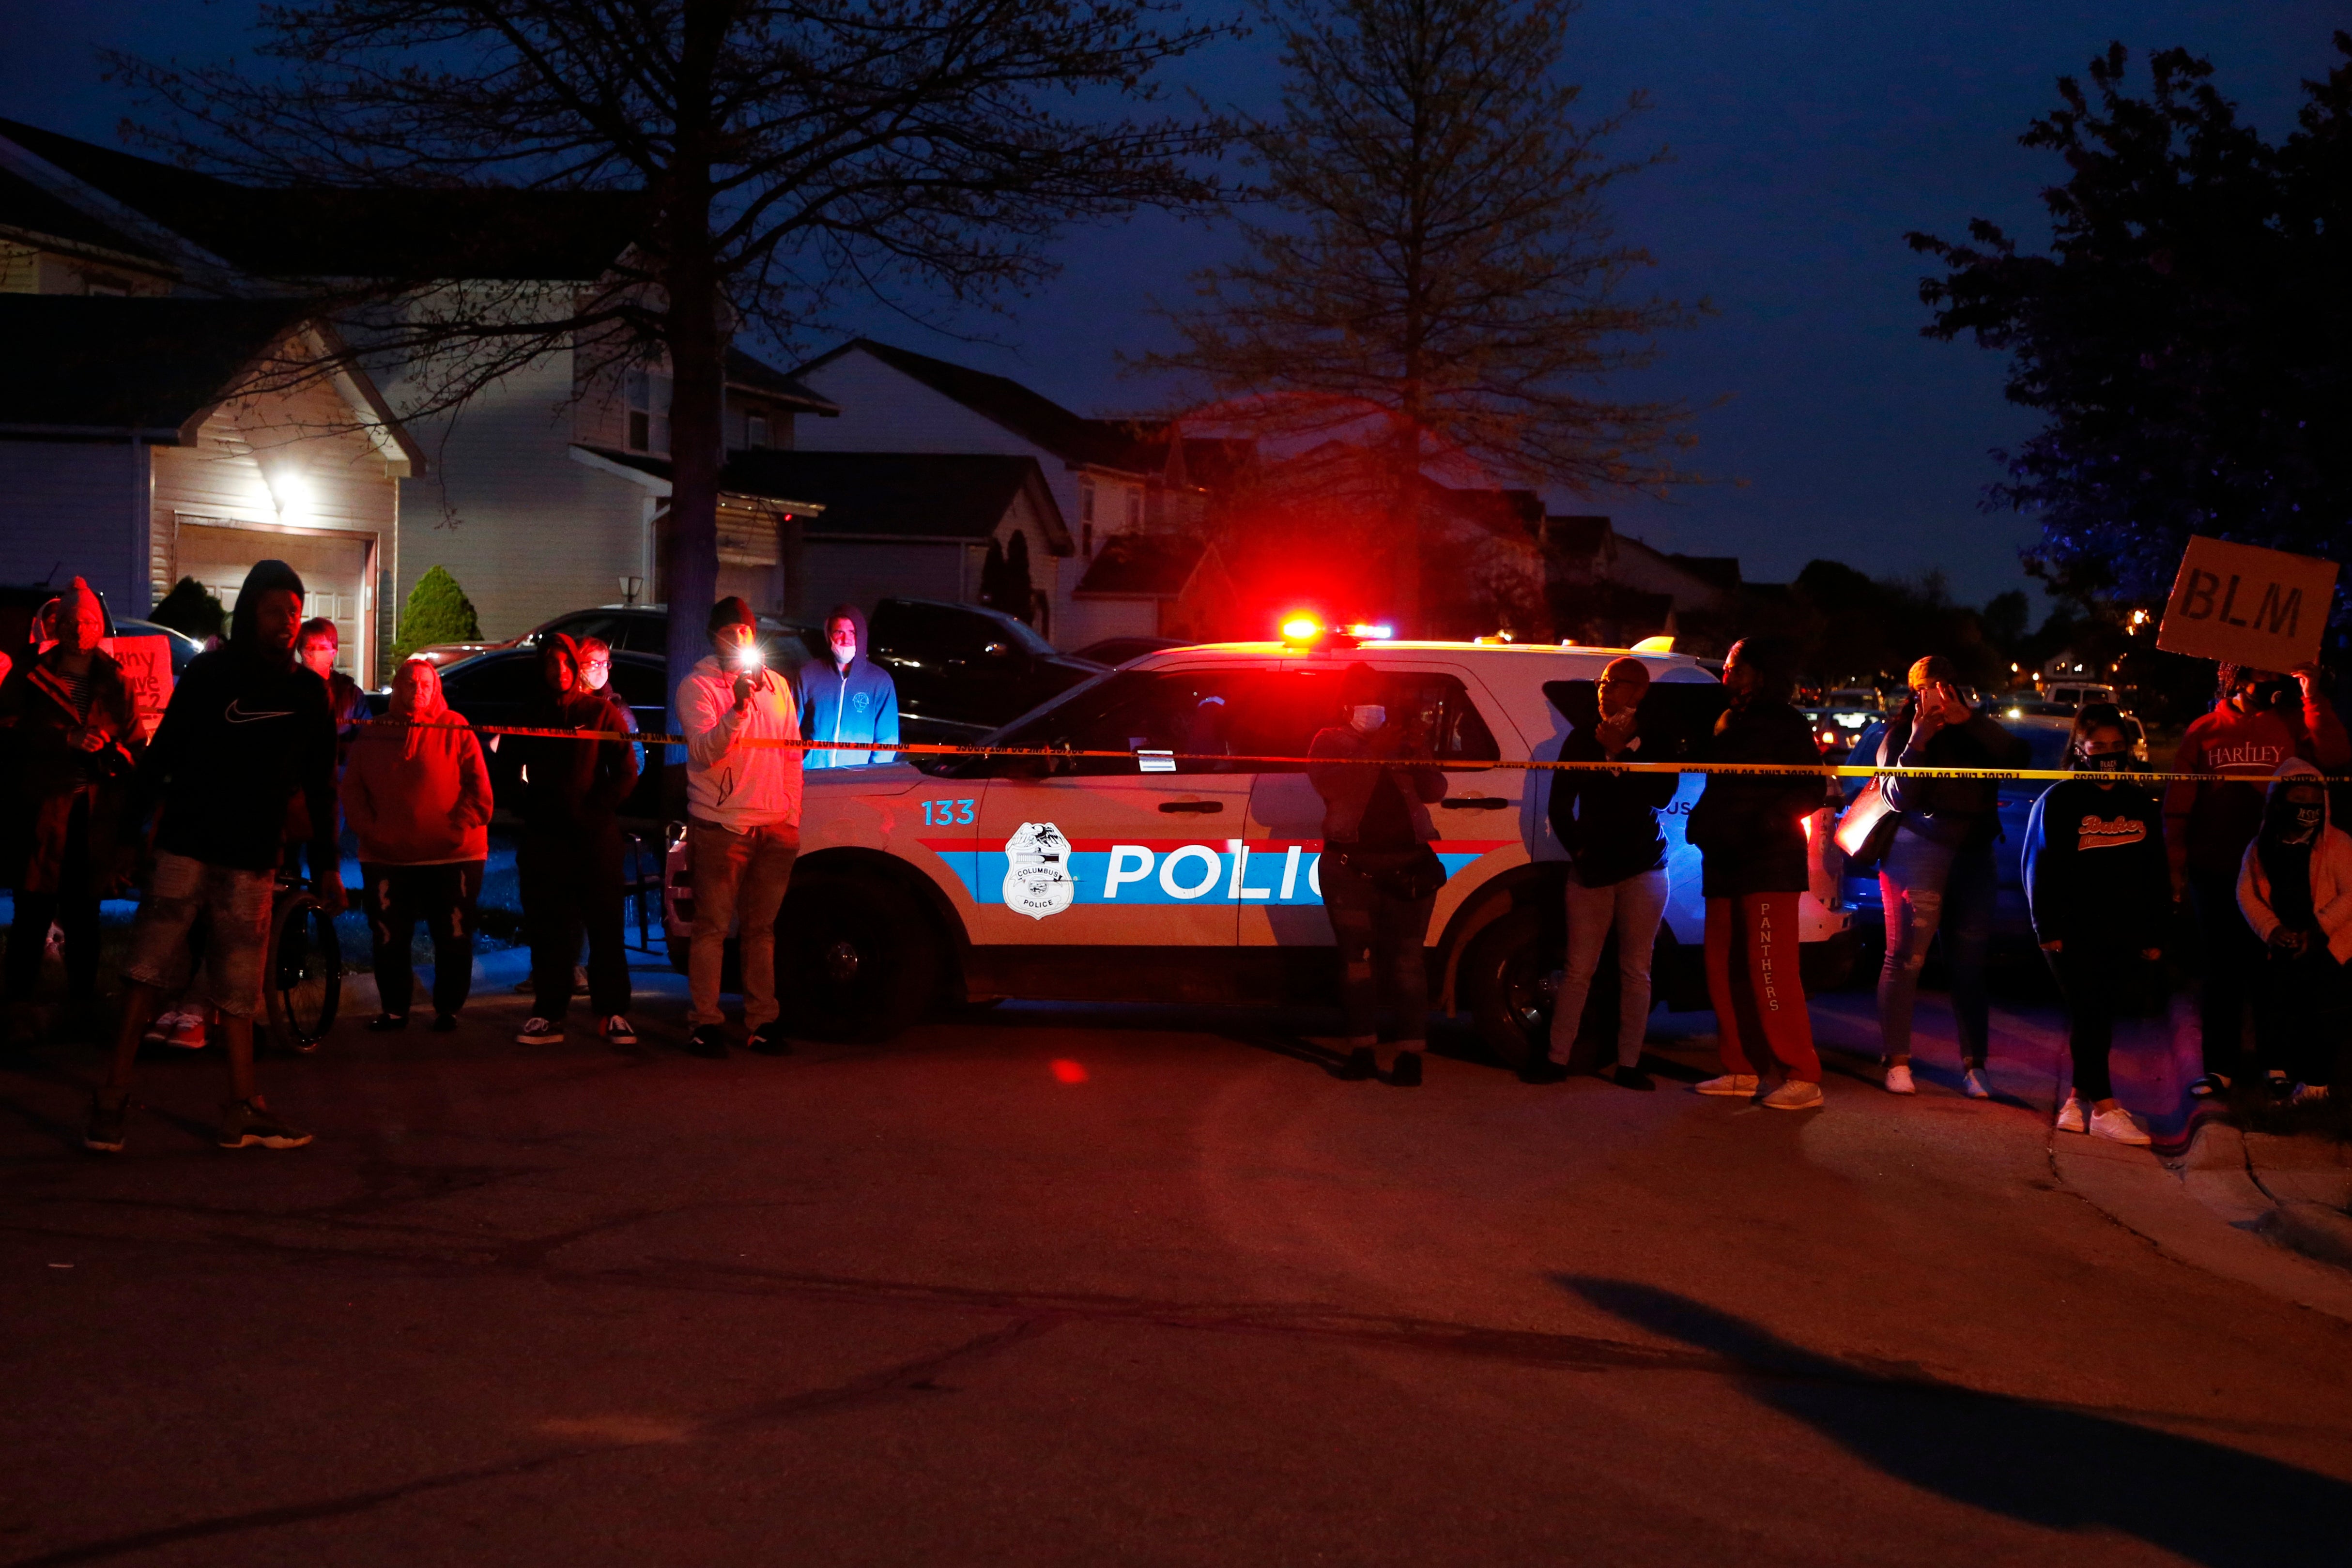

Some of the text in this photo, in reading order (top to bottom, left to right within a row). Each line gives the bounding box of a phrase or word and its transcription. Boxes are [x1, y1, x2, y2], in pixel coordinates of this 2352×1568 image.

[2179, 568, 2303, 638] BLM
[114, 652, 155, 677] any
[2209, 741, 2285, 765] HARTLEY
[922, 799, 975, 826] 133
[1017, 868, 1059, 877] COLUMBUS
[1104, 845, 1324, 900] POLI
[1024, 899, 1054, 908] POLICE
[1760, 903, 1779, 1011] PANTHERS
